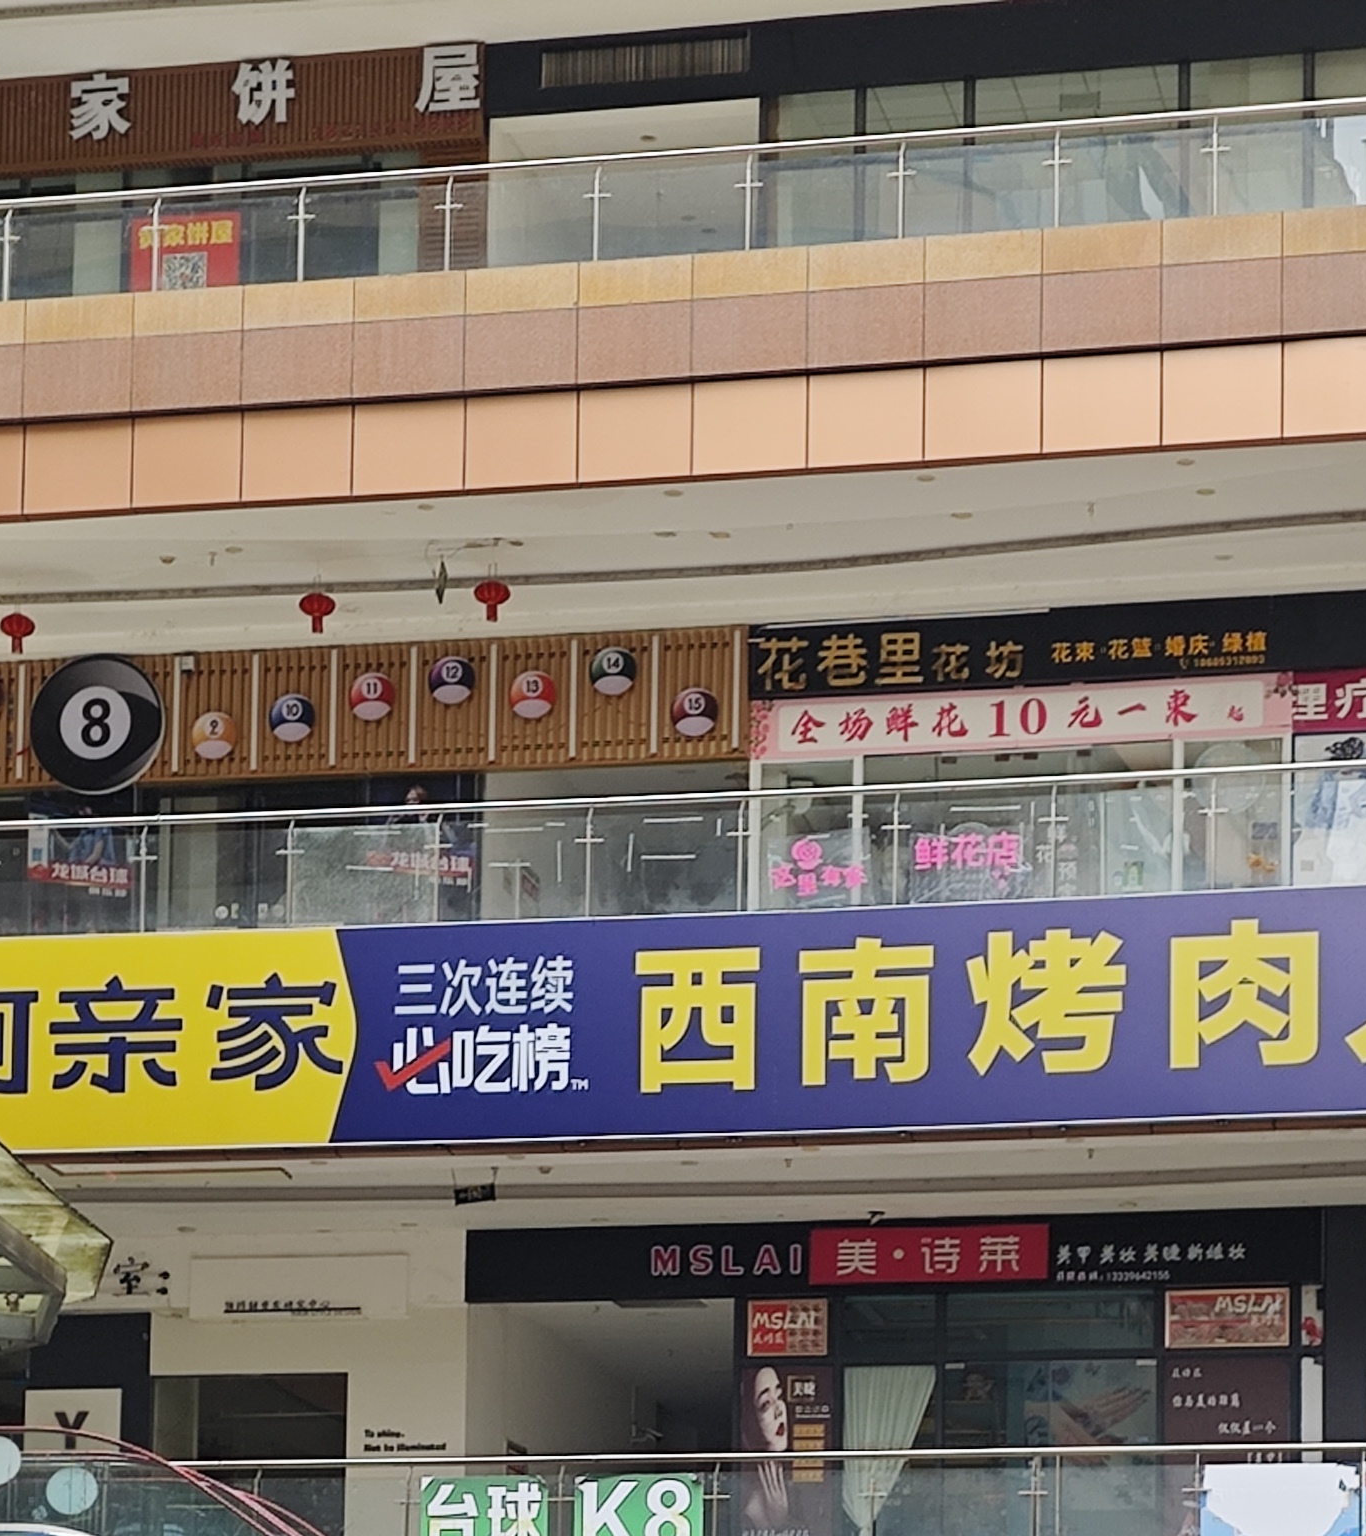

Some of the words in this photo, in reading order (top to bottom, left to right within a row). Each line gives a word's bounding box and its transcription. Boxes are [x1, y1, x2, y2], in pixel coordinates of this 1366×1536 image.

[81, 697, 111, 748] 8
[791, 690, 1201, 745] 全场鲜花10元一束
[914, 831, 1020, 871] 鲜花店
[394, 955, 575, 1017] 三次连续
[380, 1023, 572, 1096] 必吃榜
[651, 1244, 803, 1277] MSLAI
